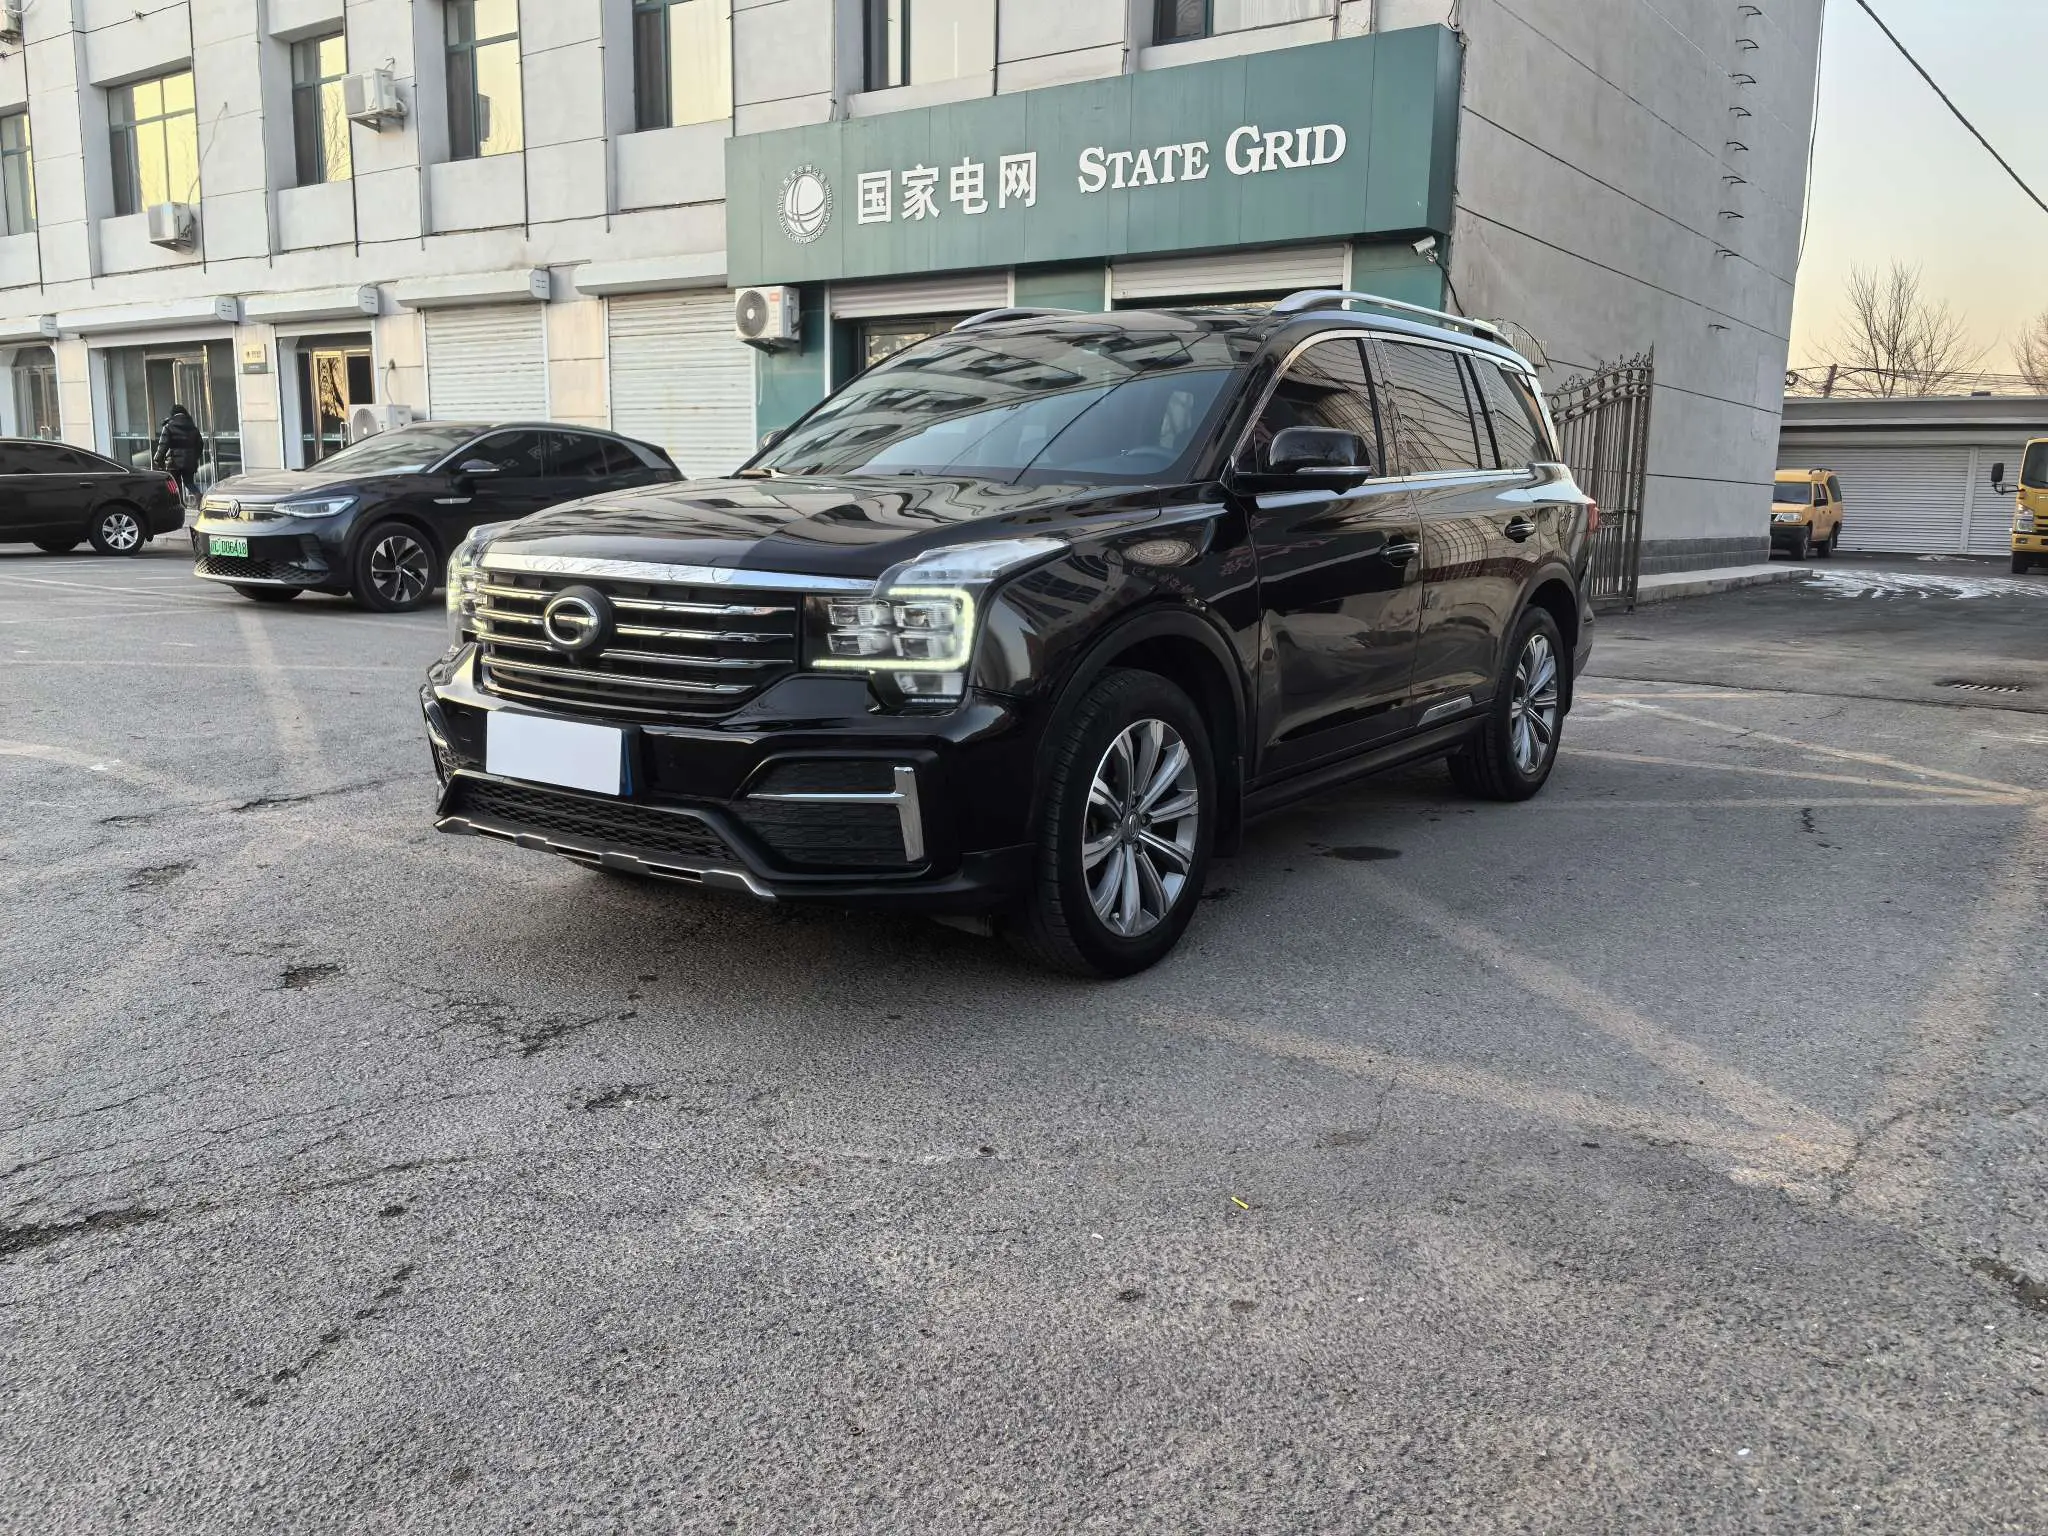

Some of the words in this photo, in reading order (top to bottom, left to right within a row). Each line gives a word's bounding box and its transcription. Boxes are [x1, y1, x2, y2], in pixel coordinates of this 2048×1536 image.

[857, 151, 1037, 225] 国家电网
[1078, 141, 1210, 194] STATE
[1225, 123, 1347, 176] GRID
